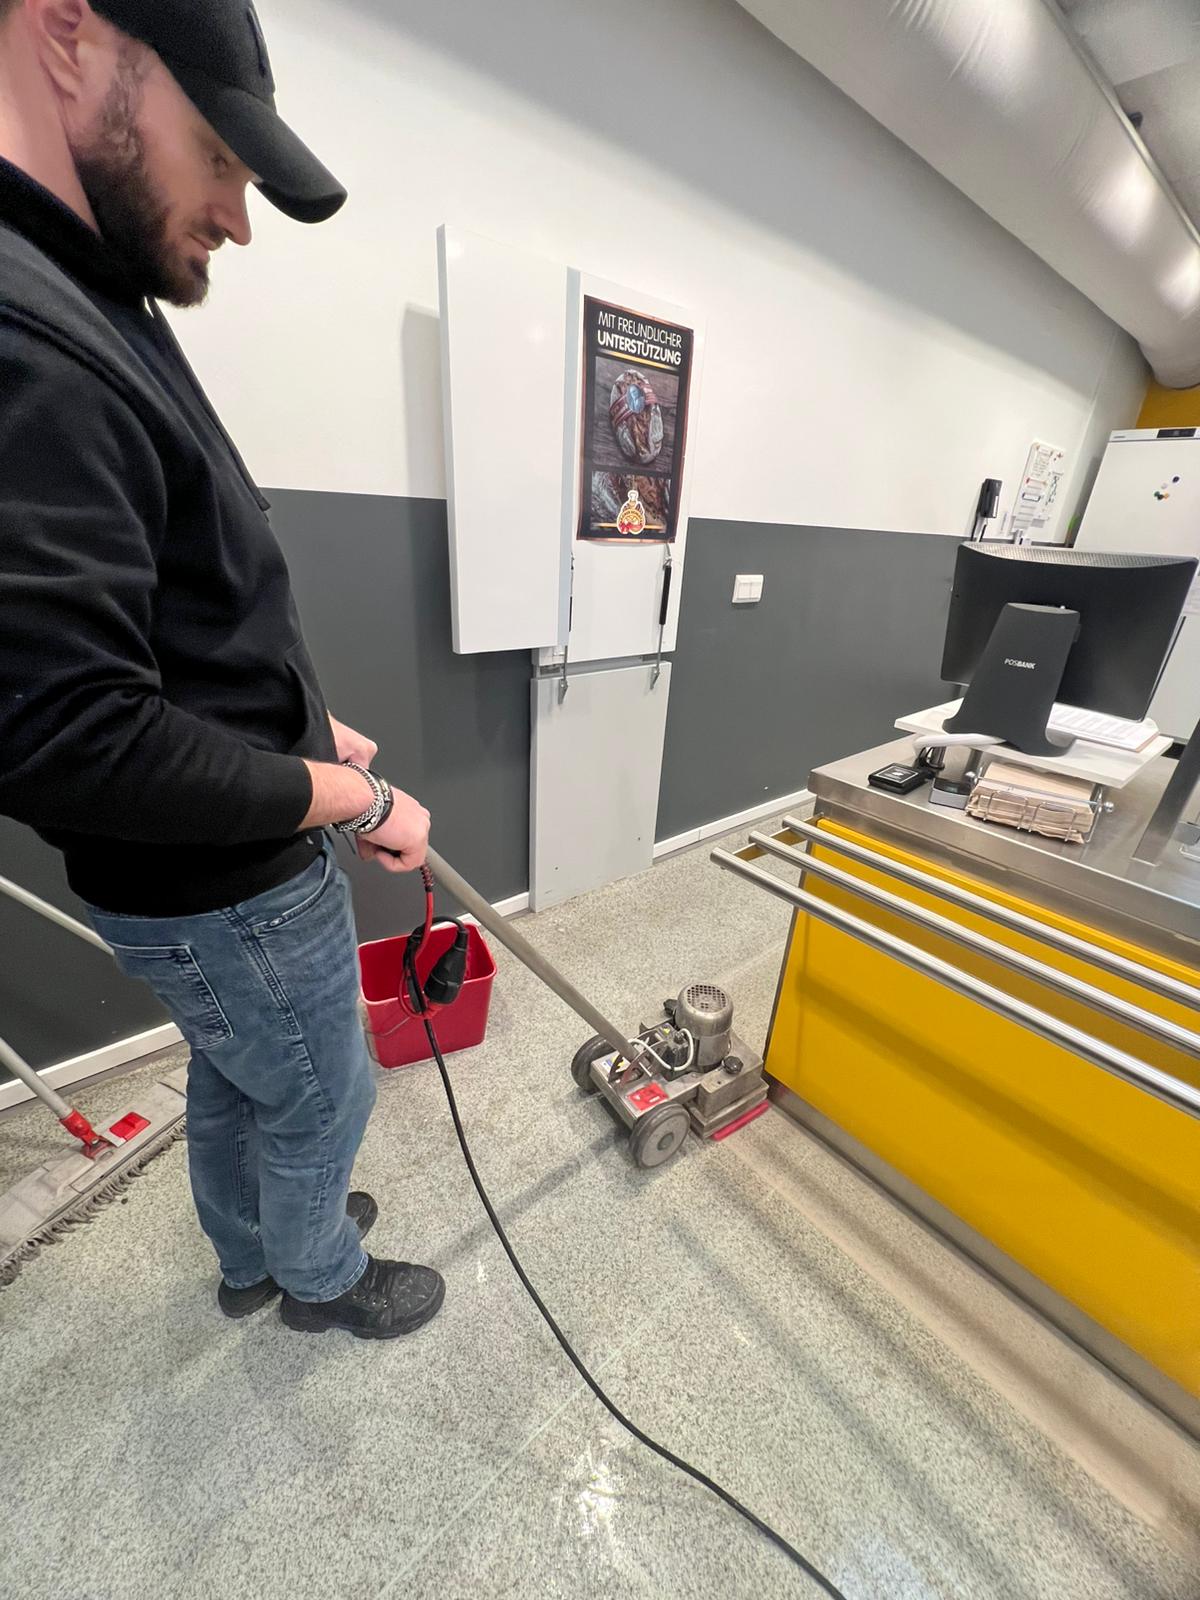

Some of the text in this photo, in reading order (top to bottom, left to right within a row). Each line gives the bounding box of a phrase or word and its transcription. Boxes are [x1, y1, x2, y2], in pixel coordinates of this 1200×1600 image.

[597, 329, 682, 366] UNTERSTÜTZUNG
[598, 310, 682, 348] MIT FREUNDLICHER
[1004, 658, 1036, 669] POSBANK
